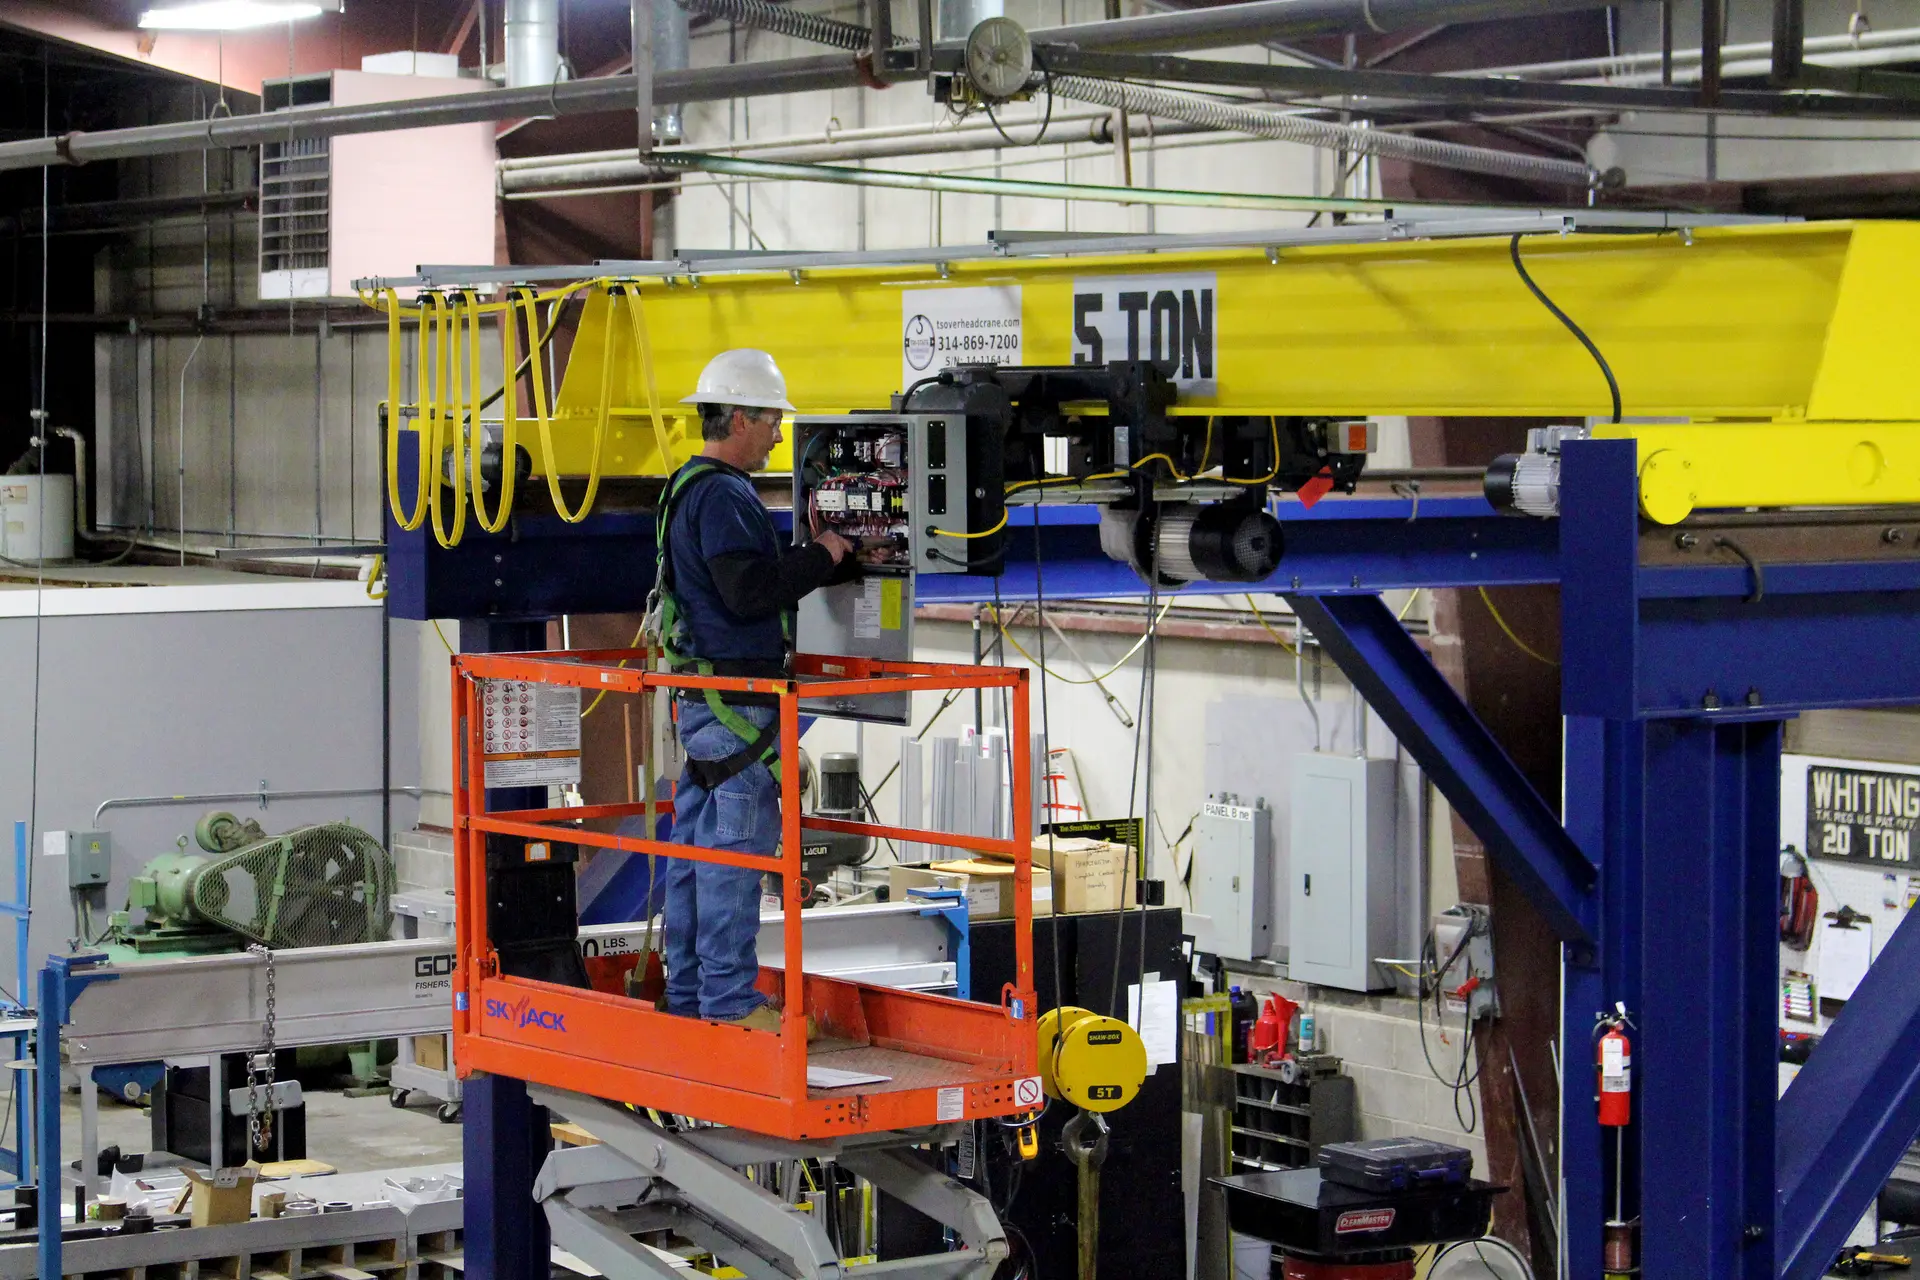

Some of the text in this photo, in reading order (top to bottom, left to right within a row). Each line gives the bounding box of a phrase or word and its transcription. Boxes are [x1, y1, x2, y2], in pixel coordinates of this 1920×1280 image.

[937, 318, 1020, 330] tsoverheadcrane.com
[1074, 289, 1213, 379] 5 TON
[938, 334, 1018, 351] 314-869-7200
[1812, 771, 1920, 819] WHITING
[1206, 804, 1230, 817] PANEL
[1823, 823, 1910, 861] 20 TON
[803, 846, 828, 856] LAGUN
[603, 937, 629, 949] LBS.
[415, 979, 451, 990] FISHERS,
[485, 995, 567, 1033] SKYJACK
[1089, 1033, 1120, 1041] SHAW-BOX
[1096, 1087, 1114, 1098] 5T
